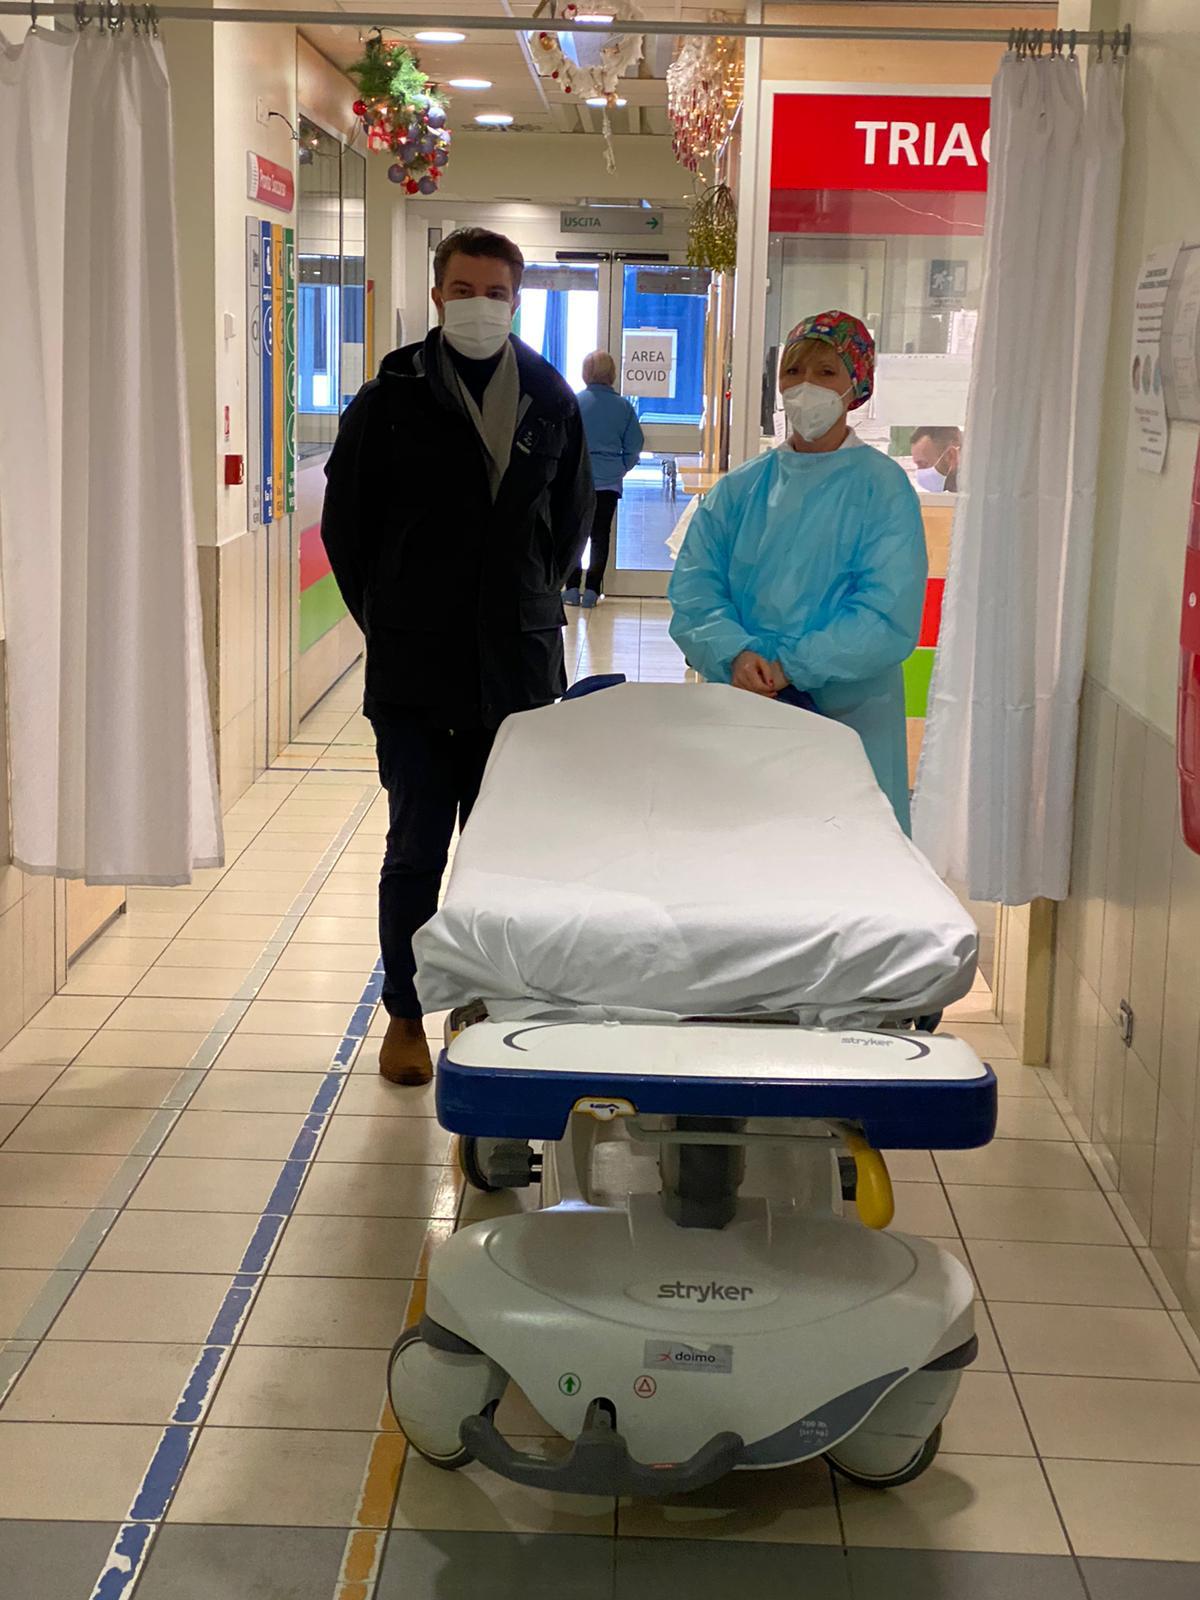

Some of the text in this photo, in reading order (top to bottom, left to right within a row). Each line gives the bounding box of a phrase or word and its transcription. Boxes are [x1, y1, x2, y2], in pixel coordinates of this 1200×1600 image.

[855, 121, 990, 166] TRIA
[564, 217, 601, 227] USCITA
[631, 351, 665, 362] AREA
[626, 369, 667, 382] COVID
[841, 1037, 894, 1046] stryker
[657, 1281, 753, 1303] stryker
[675, 1352, 716, 1363] doimo
